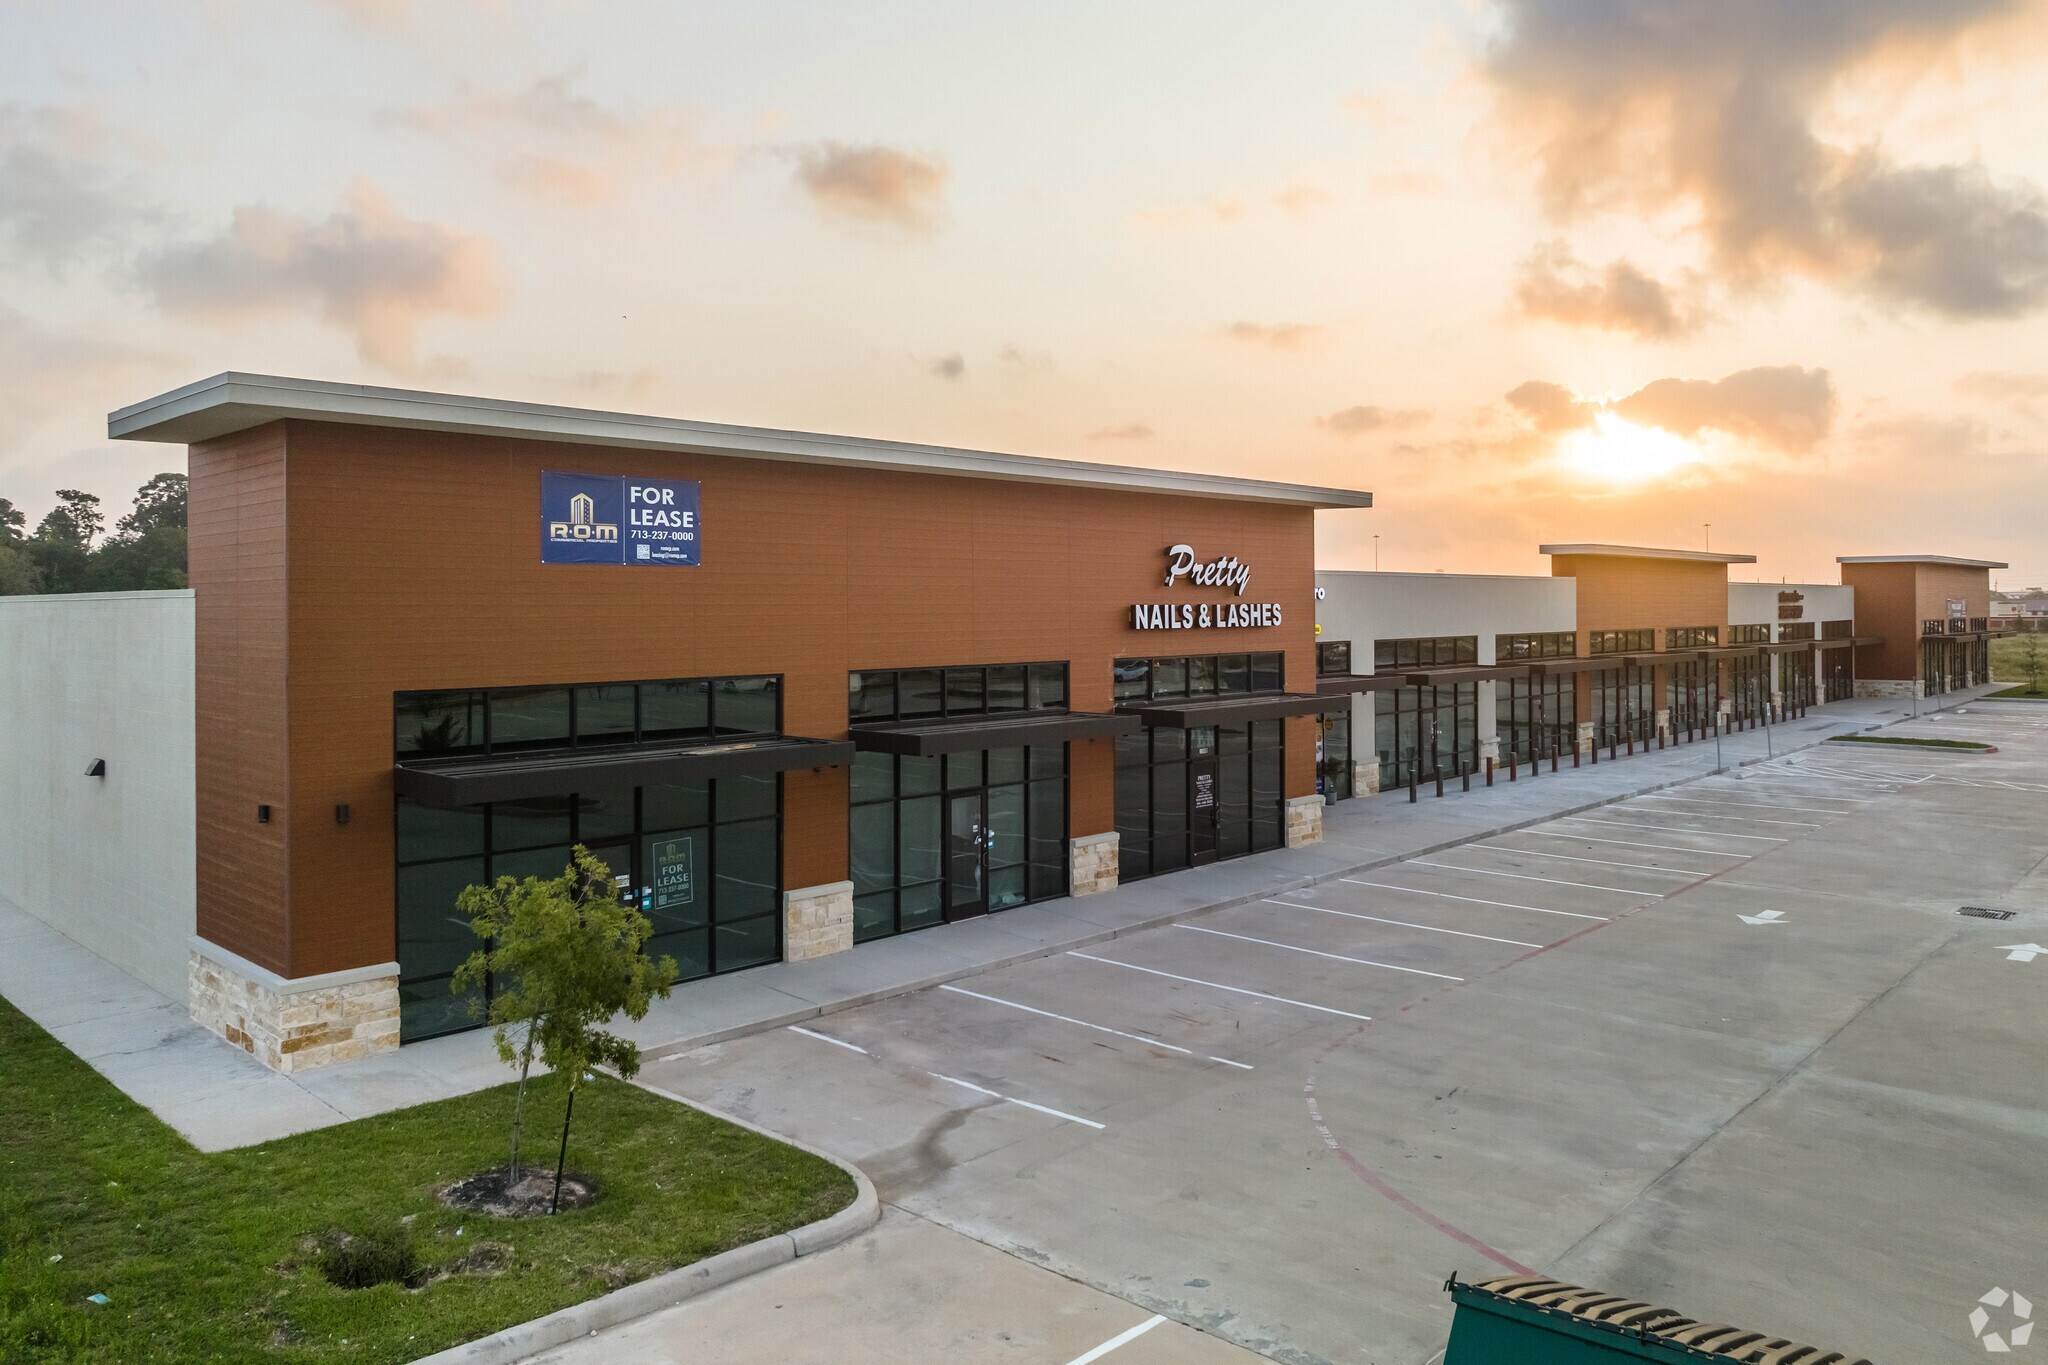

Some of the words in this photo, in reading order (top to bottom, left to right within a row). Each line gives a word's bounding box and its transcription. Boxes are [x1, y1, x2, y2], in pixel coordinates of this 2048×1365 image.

[630, 486, 675, 506] FOR
[630, 508, 694, 528] LEASE
[630, 529, 694, 541] 713-237-0000
[1164, 543, 1251, 597] Pretty
[1133, 603, 1194, 630] NAILS
[1198, 603, 1212, 628] &
[1216, 603, 1283, 628] LASHES
[657, 872, 690, 887] LEASE
[662, 863, 684, 876] FOR
